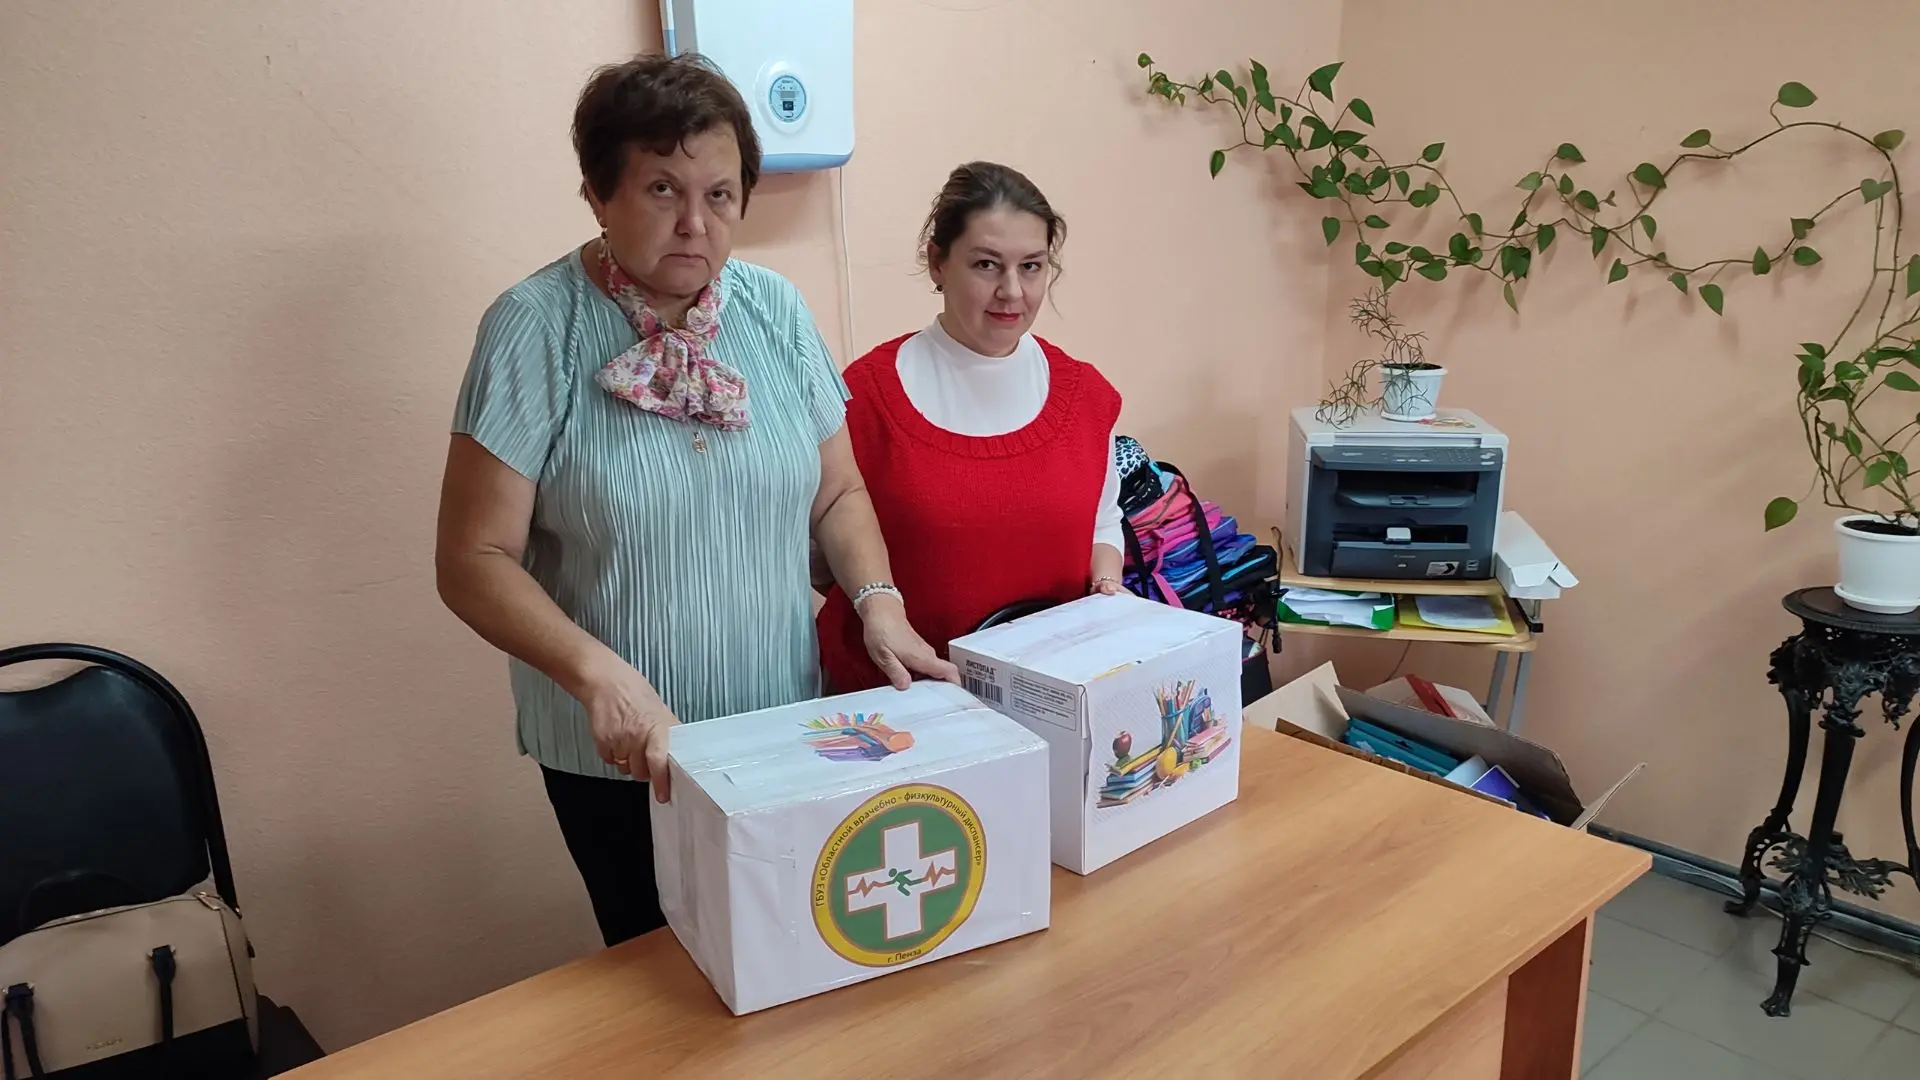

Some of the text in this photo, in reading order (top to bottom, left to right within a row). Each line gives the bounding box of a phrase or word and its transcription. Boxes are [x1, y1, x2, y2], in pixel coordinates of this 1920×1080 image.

[815, 884, 825, 907] ГБУЗ
[820, 825, 854, 881] «Областной
[853, 796, 897, 827] врачебно
[903, 791, 967, 819] физкультурный
[963, 816, 982, 866] диспансер»
[895, 948, 922, 962] Пенза
